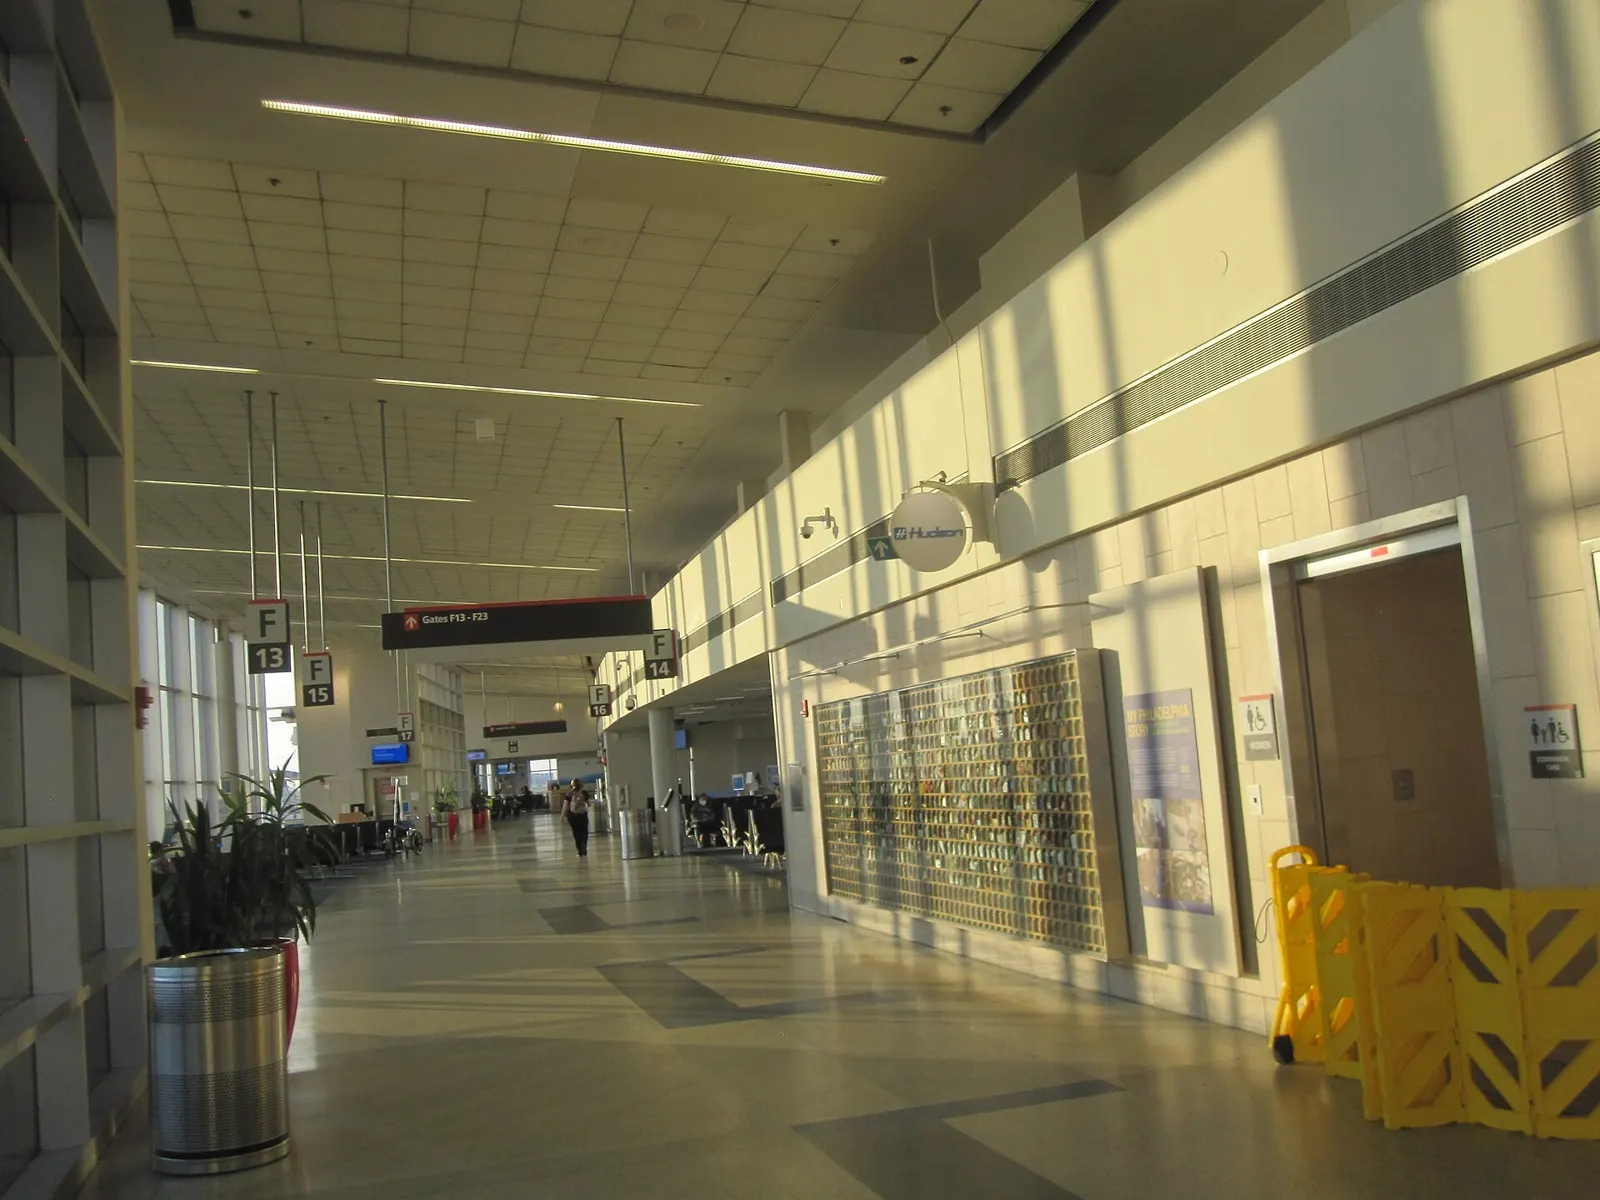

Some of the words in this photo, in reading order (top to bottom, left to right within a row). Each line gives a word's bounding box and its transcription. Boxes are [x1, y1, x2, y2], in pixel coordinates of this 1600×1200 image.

[909, 526, 963, 539] Hudson
[259, 609, 276, 638] F
[422, 615, 448, 624] Gates
[449, 613, 466, 622] F13
[472, 612, 489, 621] F23
[653, 634, 666, 656] F
[256, 647, 284, 669] 13
[310, 659, 323, 681] F
[649, 661, 670, 677] 14
[308, 687, 329, 703] 15
[595, 687, 604, 702] F
[592, 704, 607, 716] 16
[402, 716, 409, 729] F
[400, 731, 412, 741] 17
